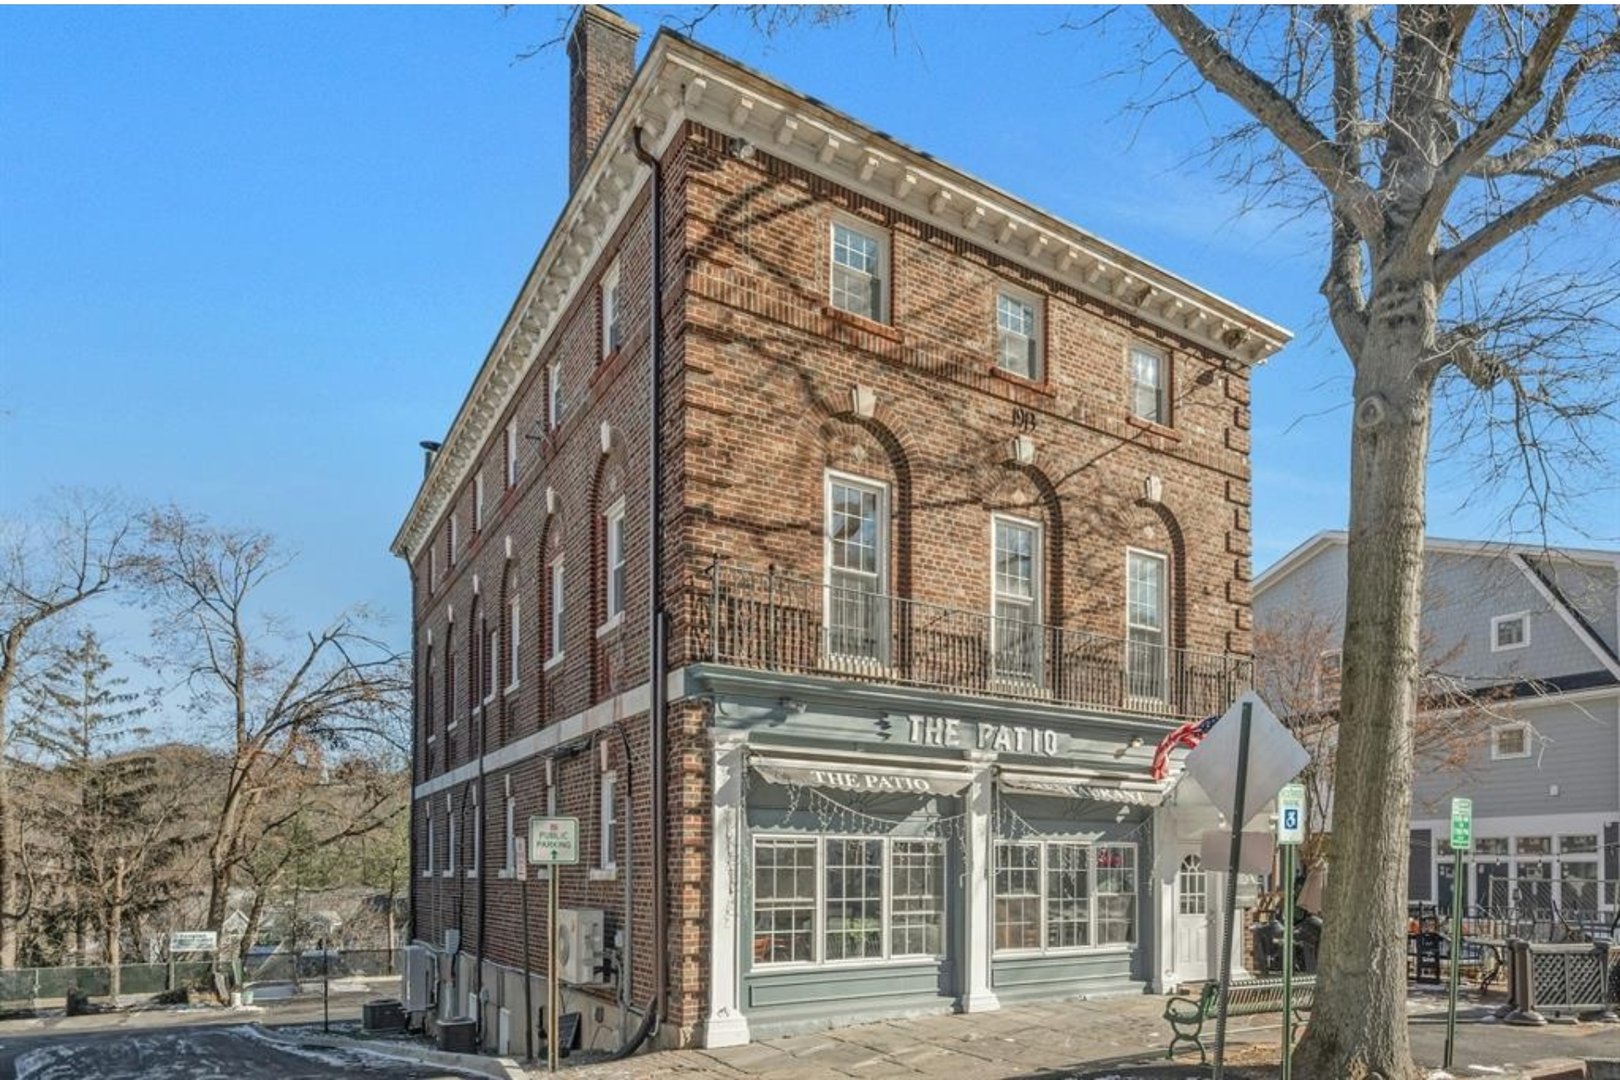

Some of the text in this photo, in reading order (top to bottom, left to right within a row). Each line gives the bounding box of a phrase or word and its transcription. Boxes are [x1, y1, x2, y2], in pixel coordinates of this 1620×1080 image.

[908, 714, 1058, 757] THE PATIO
[811, 770, 930, 791] THE PATIO
[536, 841, 571, 849] PARKING
